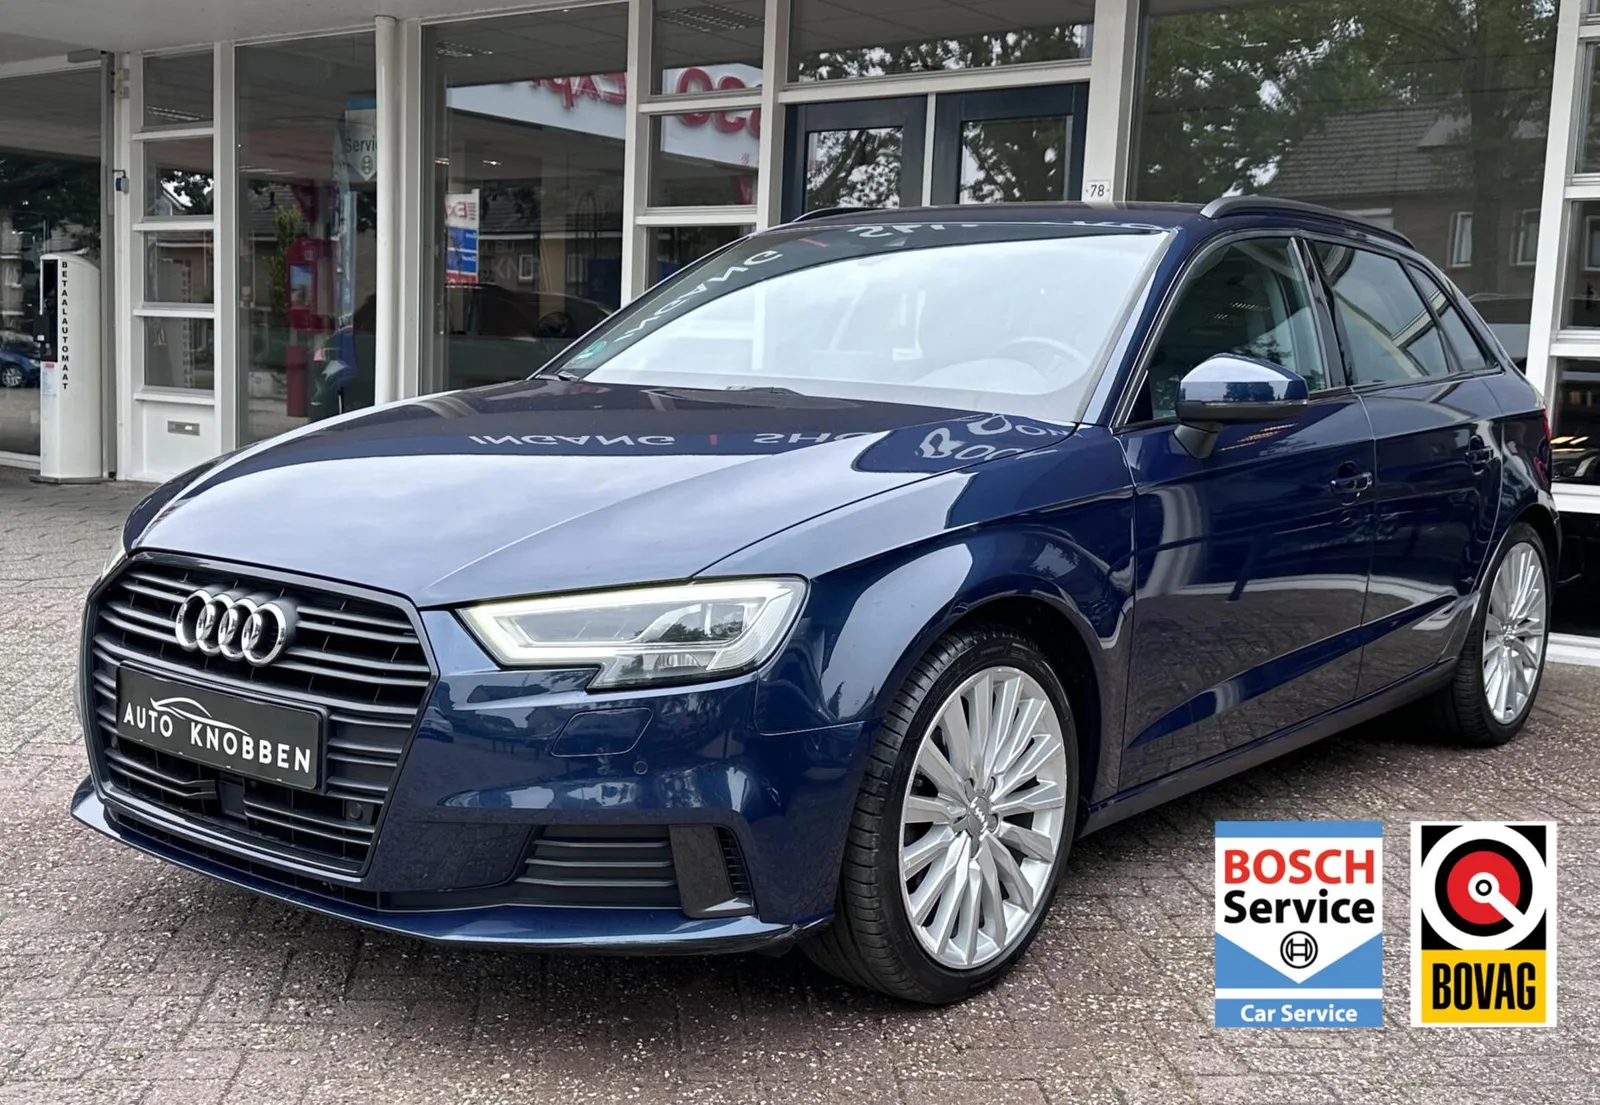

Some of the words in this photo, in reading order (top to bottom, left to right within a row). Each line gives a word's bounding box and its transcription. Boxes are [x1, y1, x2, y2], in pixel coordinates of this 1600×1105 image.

[345, 135, 377, 153] Servi
[1090, 184, 1105, 197] 78
[61, 260, 70, 390] BETAALAUTOMAAT
[123, 702, 173, 737] AUTO
[190, 721, 311, 774] KNOBBEN
